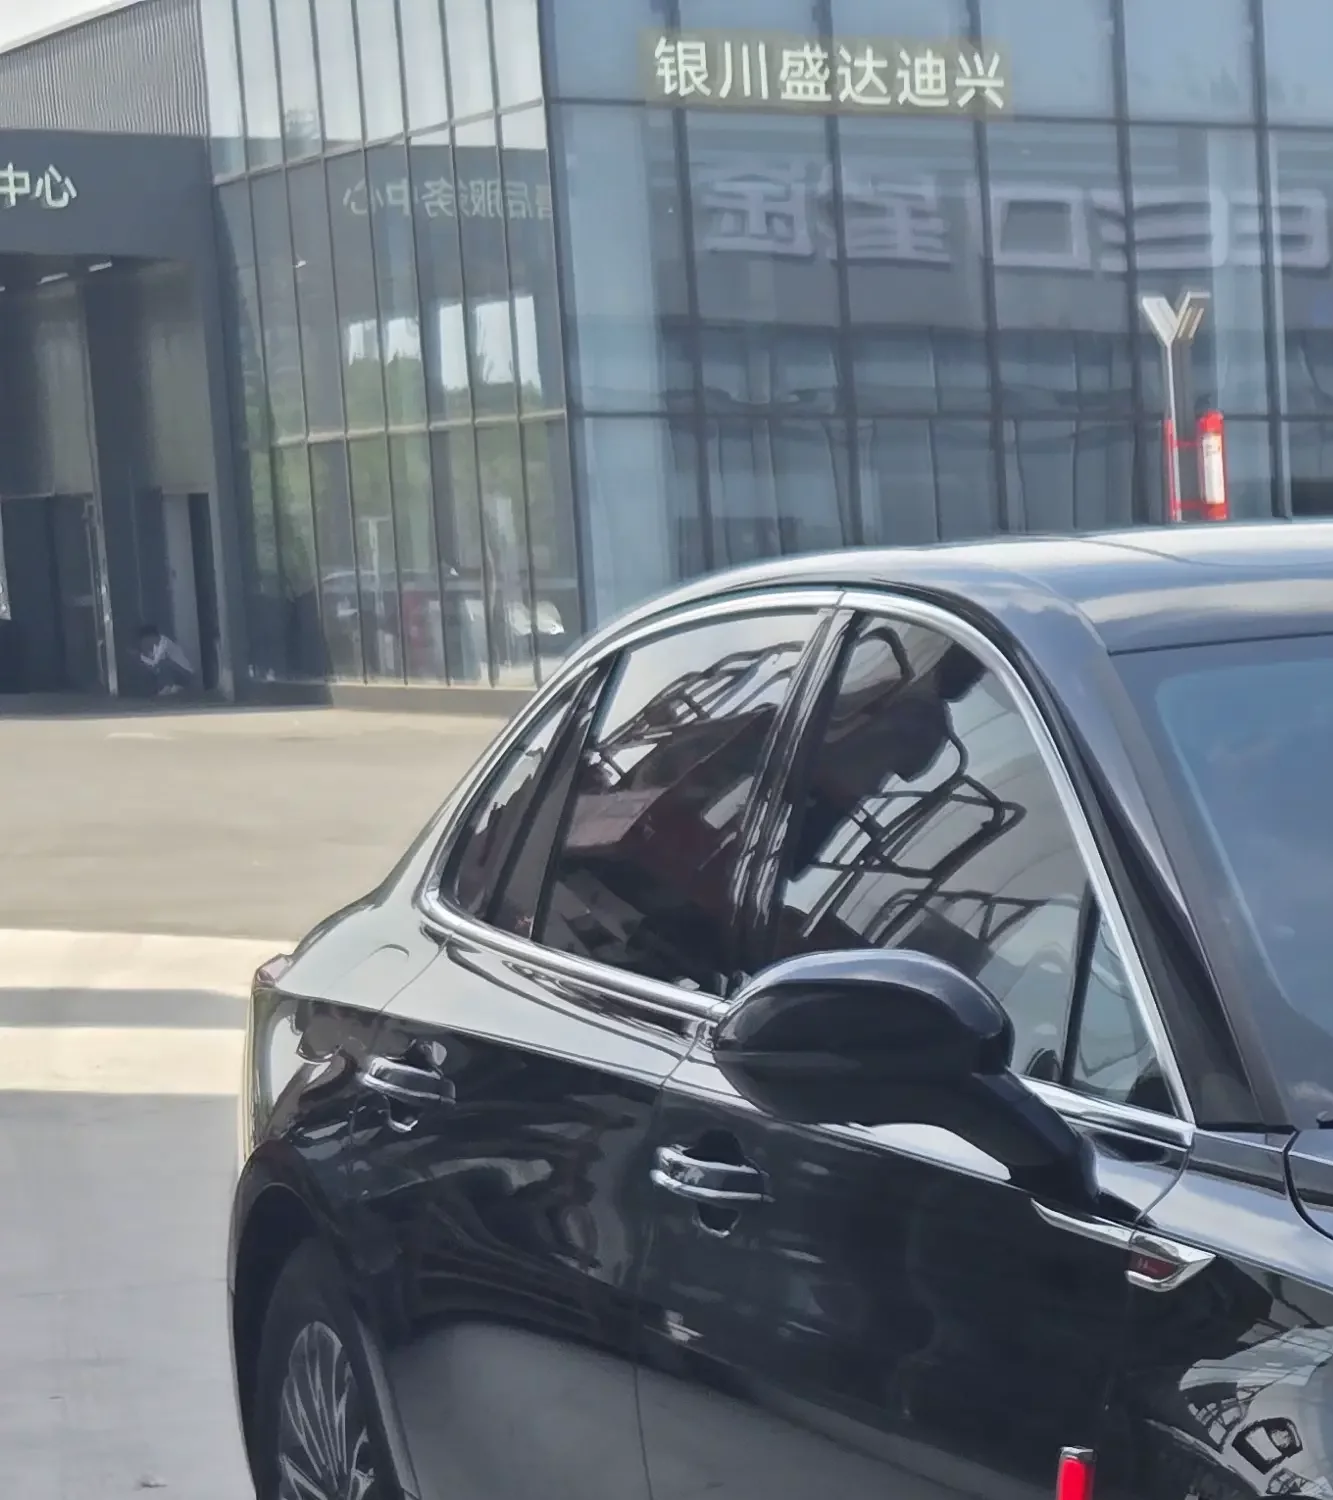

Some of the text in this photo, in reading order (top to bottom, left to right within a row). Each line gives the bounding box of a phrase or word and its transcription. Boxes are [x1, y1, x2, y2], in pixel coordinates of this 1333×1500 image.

[655, 37, 1005, 109] 银川盛达迪兴
[0, 162, 78, 208] 中心
